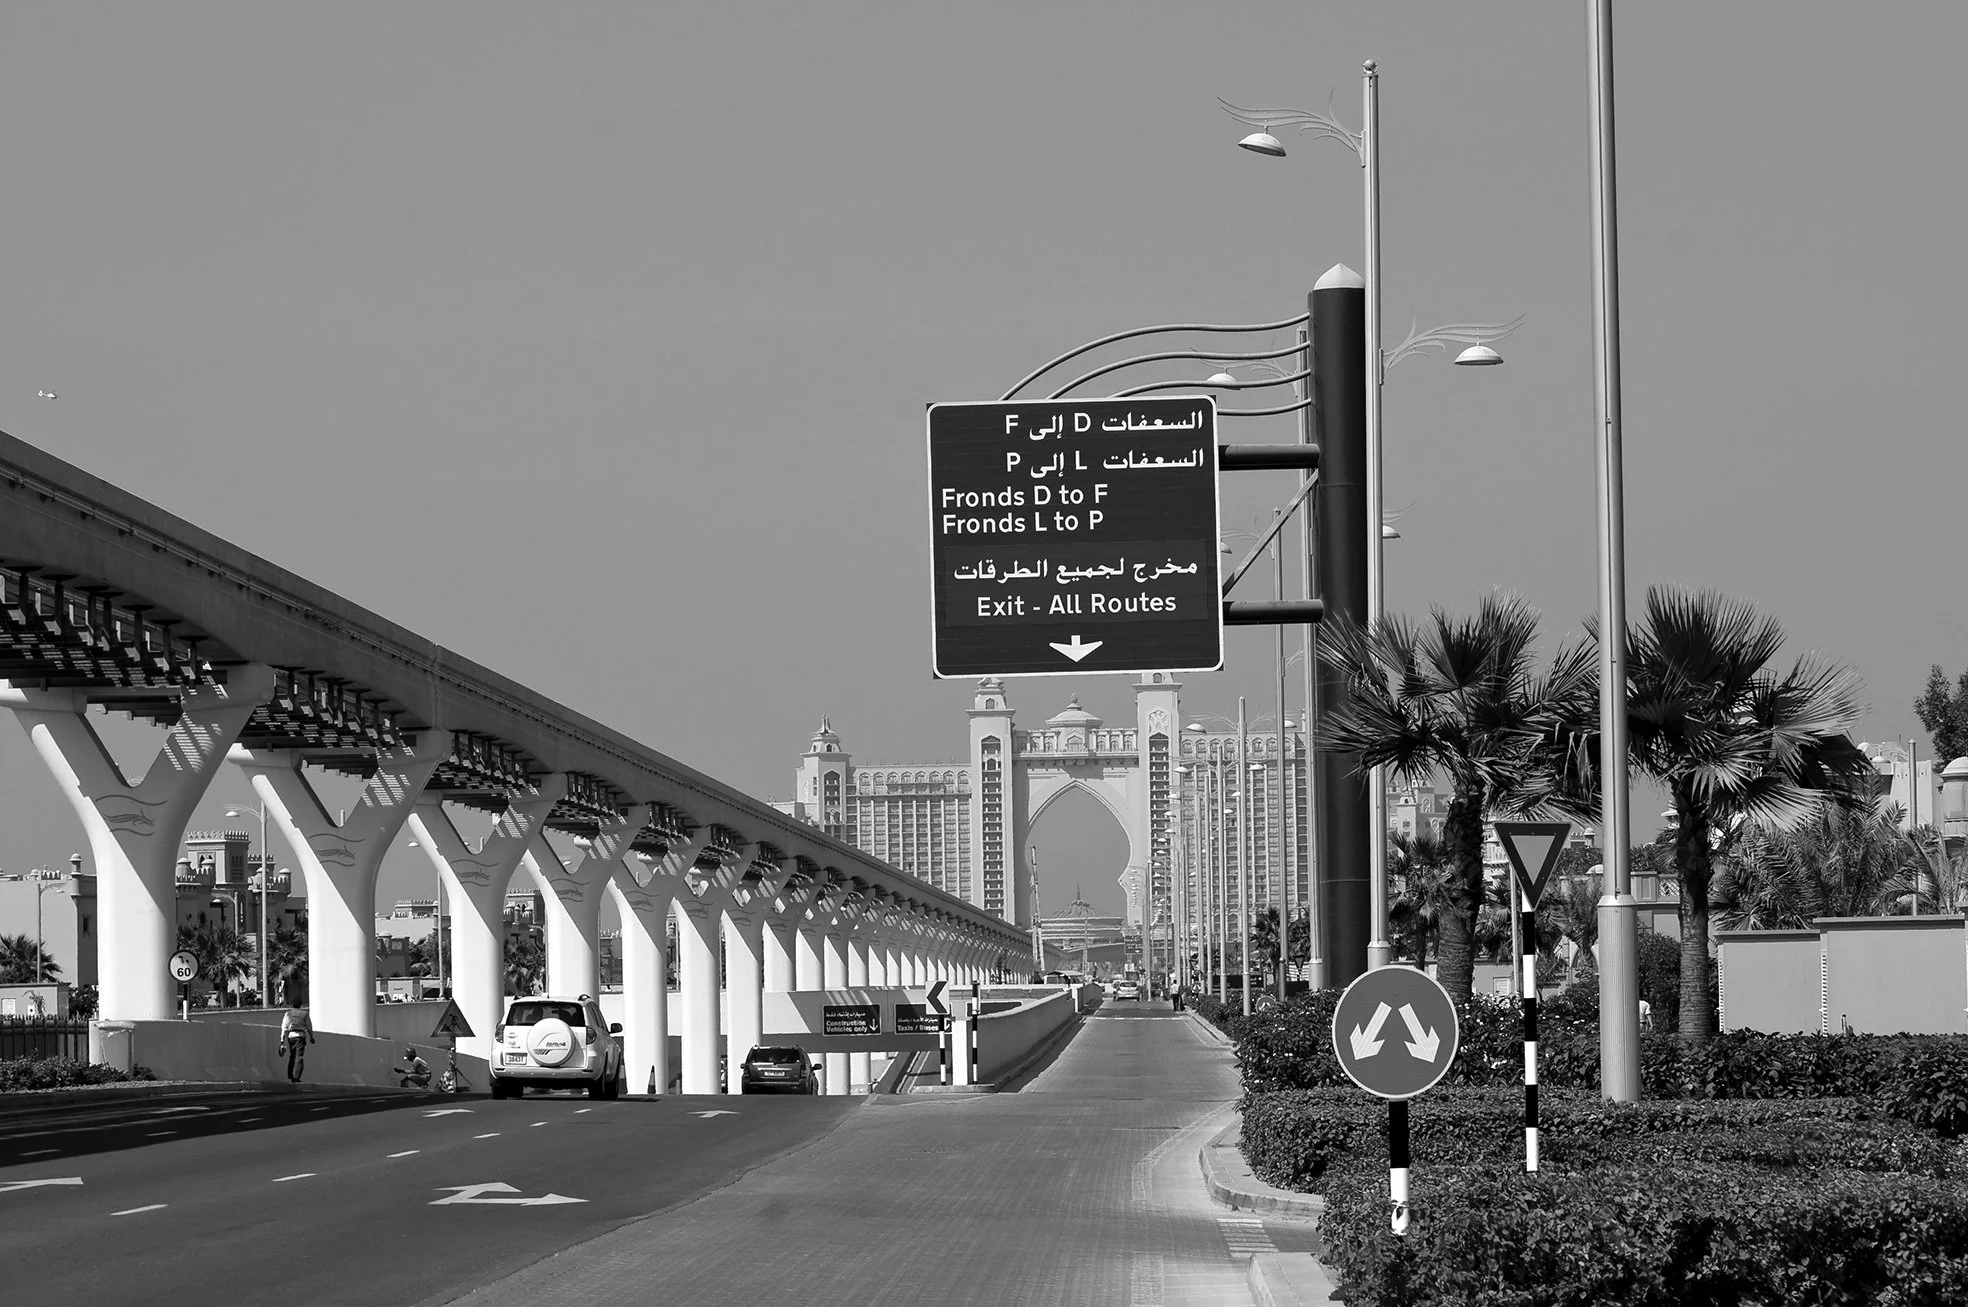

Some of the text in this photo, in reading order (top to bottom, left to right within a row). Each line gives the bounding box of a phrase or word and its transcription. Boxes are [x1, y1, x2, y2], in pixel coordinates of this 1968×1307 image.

[1005, 409, 1203, 441] السعفات D إلى F
[1006, 447, 1204, 478] السعفات L إلى P
[942, 483, 1108, 509] Fronds D to F
[942, 509, 1104, 535] Fronds L to P
[953, 556, 1198, 585] مخرج لجميع الطرقات
[977, 595, 1025, 617] Exit
[1048, 593, 1083, 615] All
[1091, 591, 1177, 614] Routes
[177, 967, 191, 977] 60
